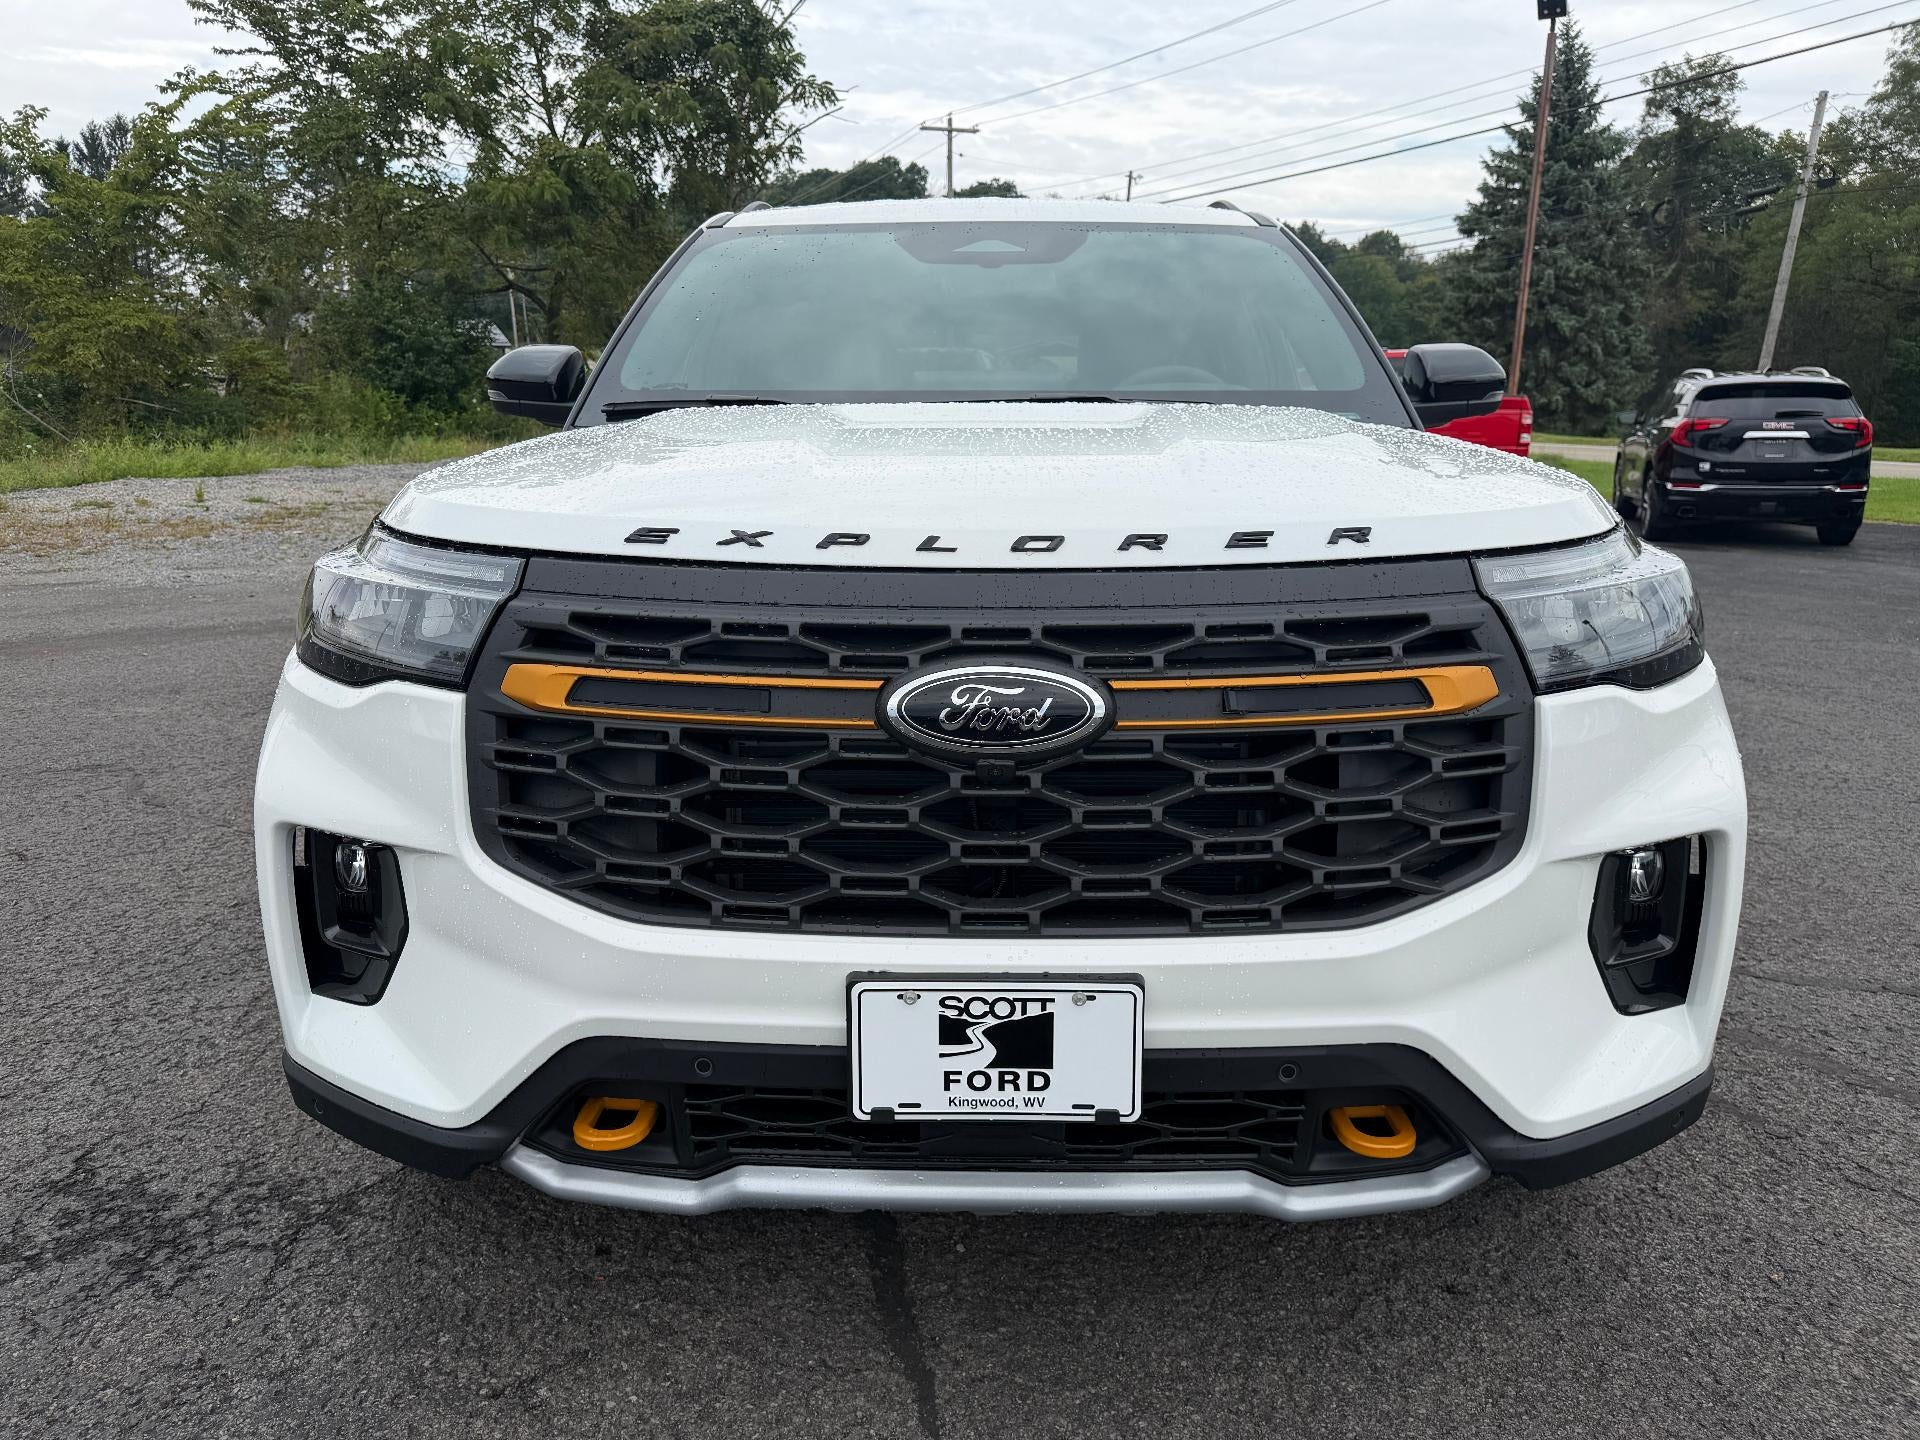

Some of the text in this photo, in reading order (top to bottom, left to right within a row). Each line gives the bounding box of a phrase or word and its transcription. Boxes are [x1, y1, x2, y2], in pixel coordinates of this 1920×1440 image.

[1762, 421, 1795, 430] GMC
[623, 525, 1374, 553] EXPLORER
[939, 683, 1054, 731] Ford
[938, 995, 1056, 1020] SCOTT
[943, 1070, 1051, 1092] FORD
[948, 1096, 1046, 1109] Kingwood, WV
